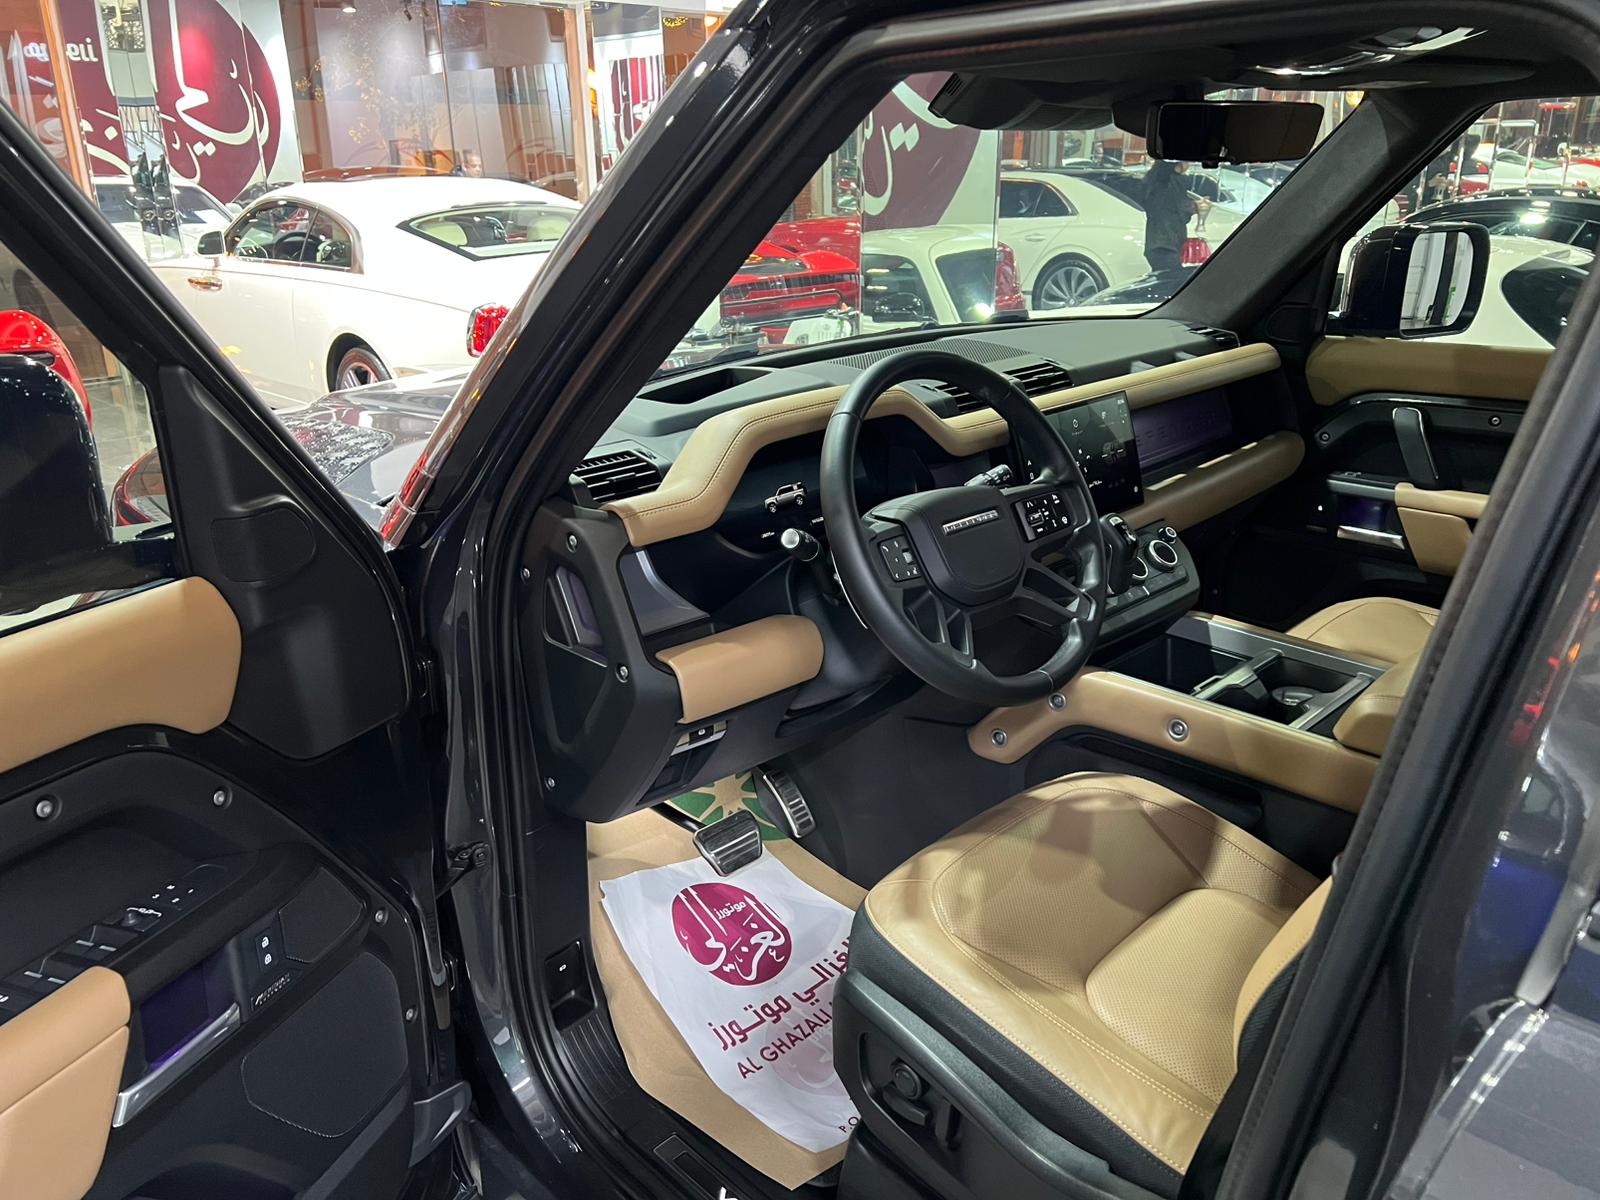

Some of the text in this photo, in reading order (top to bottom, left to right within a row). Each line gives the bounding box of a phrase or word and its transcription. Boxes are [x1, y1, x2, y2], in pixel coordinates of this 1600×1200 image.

[708, 995, 792, 1051] موتورز
[737, 1056, 763, 1079] AL
[760, 1008, 833, 1062] GHAZALI
